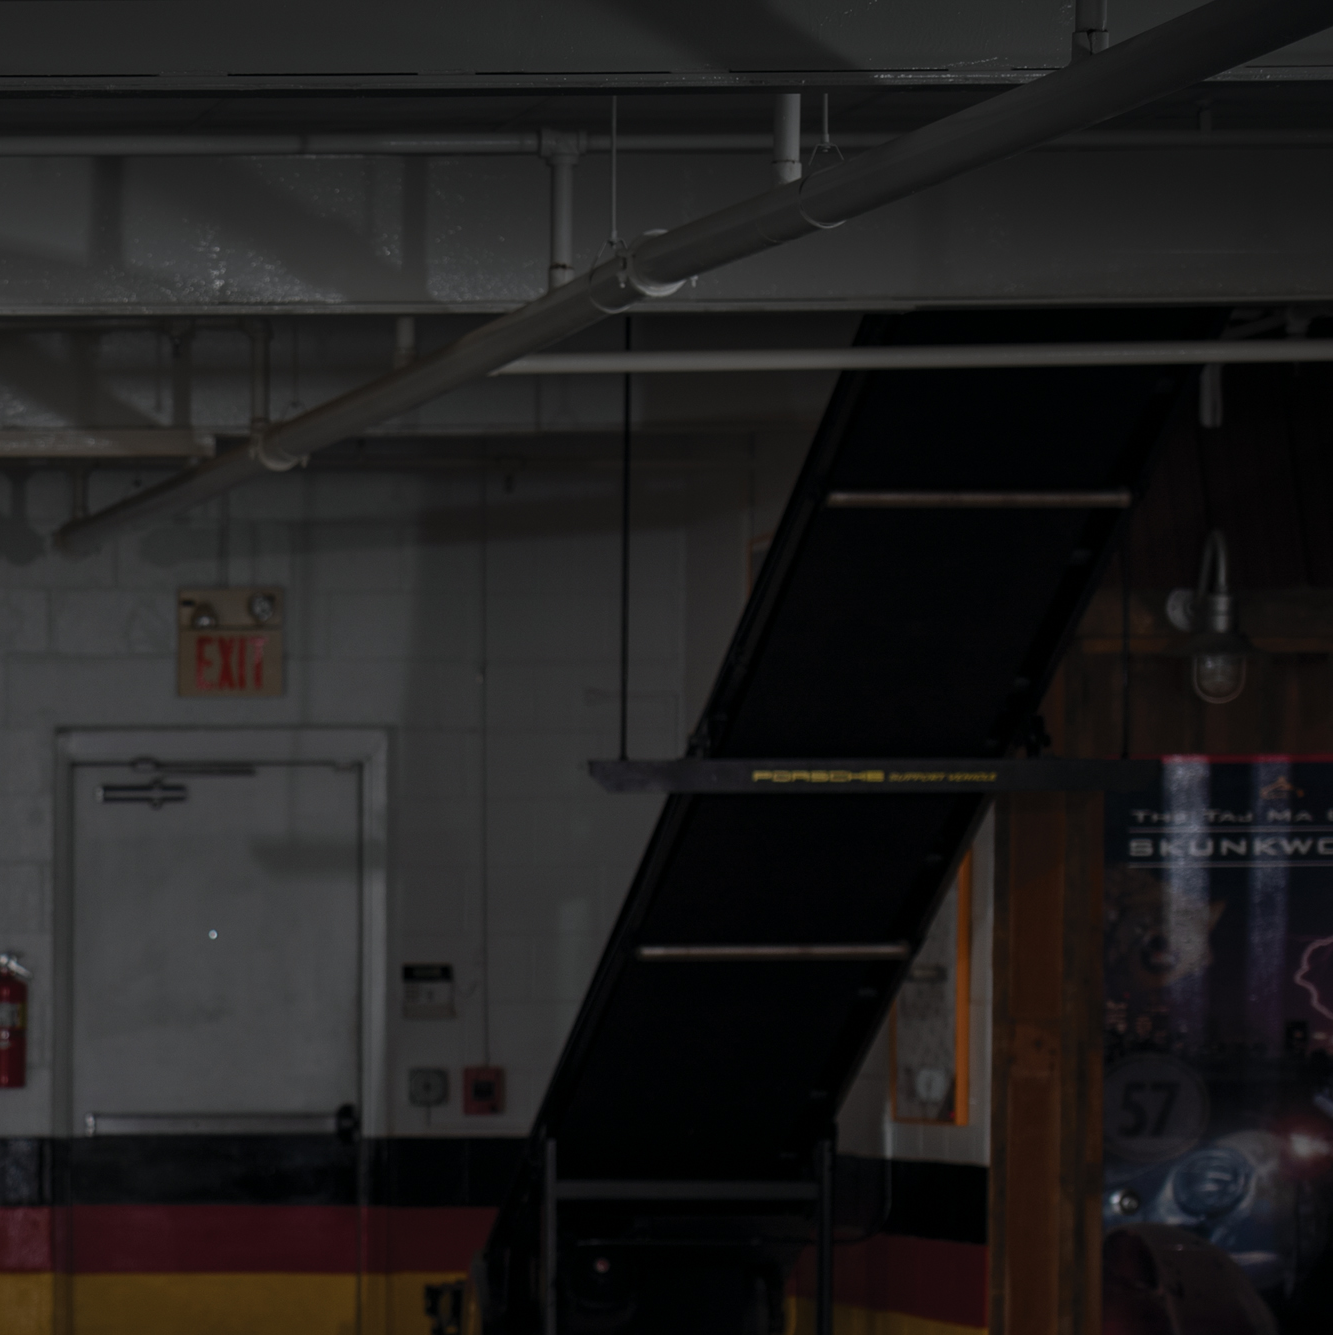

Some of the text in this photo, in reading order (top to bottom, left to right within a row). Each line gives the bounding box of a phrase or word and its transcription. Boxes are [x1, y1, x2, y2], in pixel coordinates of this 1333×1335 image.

[195, 635, 266, 691] EXIT
[752, 770, 998, 783] PORSCHE SUPPORT VEHICLE
[1117, 1080, 1182, 1138] 57
